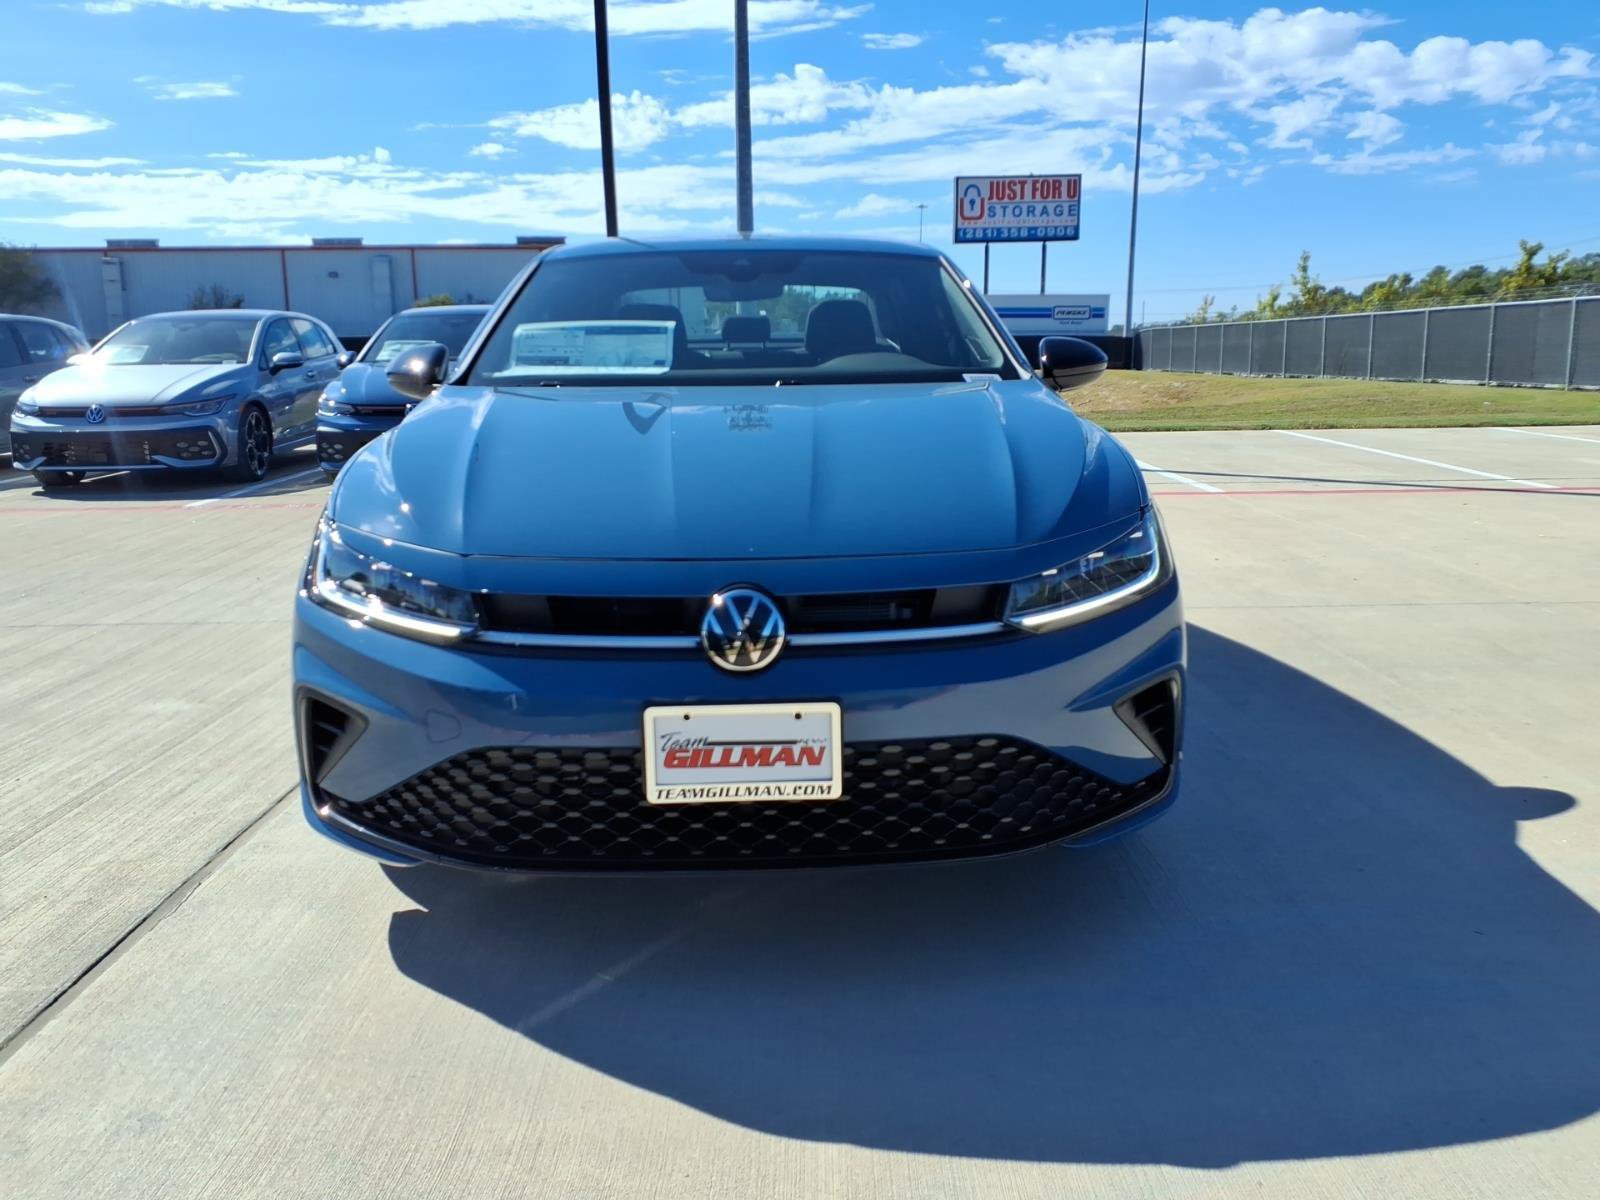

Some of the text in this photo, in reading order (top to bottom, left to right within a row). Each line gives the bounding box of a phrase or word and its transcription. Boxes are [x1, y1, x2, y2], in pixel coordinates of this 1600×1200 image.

[988, 178, 1078, 201] JUST FOR U
[987, 203, 1077, 218] STORAGE
[660, 731, 709, 751] Team
[664, 745, 826, 768] GILLMAN
[655, 784, 832, 800] TEAMGILLMAN.COM
